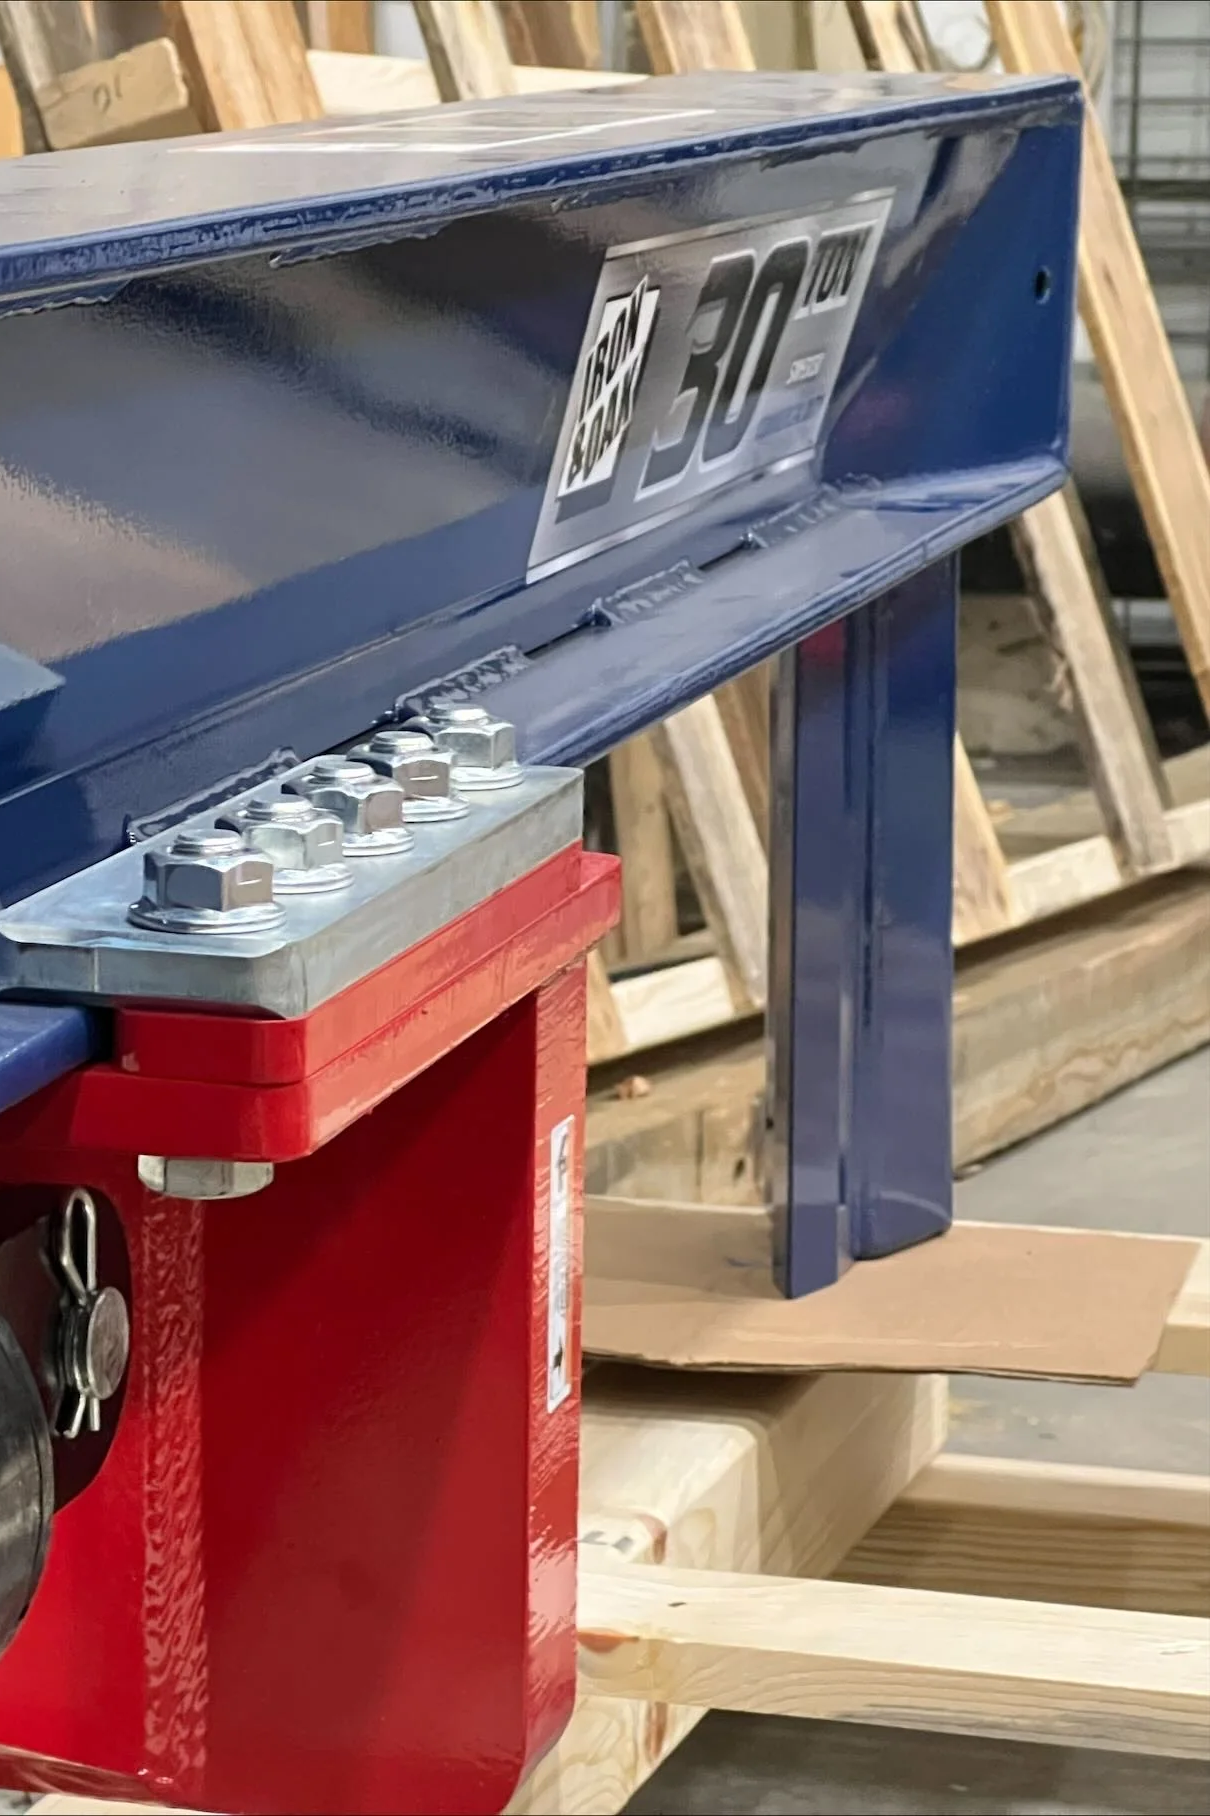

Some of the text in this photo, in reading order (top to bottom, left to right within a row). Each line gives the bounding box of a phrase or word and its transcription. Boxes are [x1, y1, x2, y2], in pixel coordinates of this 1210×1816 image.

[578, 279, 647, 424] IRON
[637, 221, 876, 500] 30 TON
